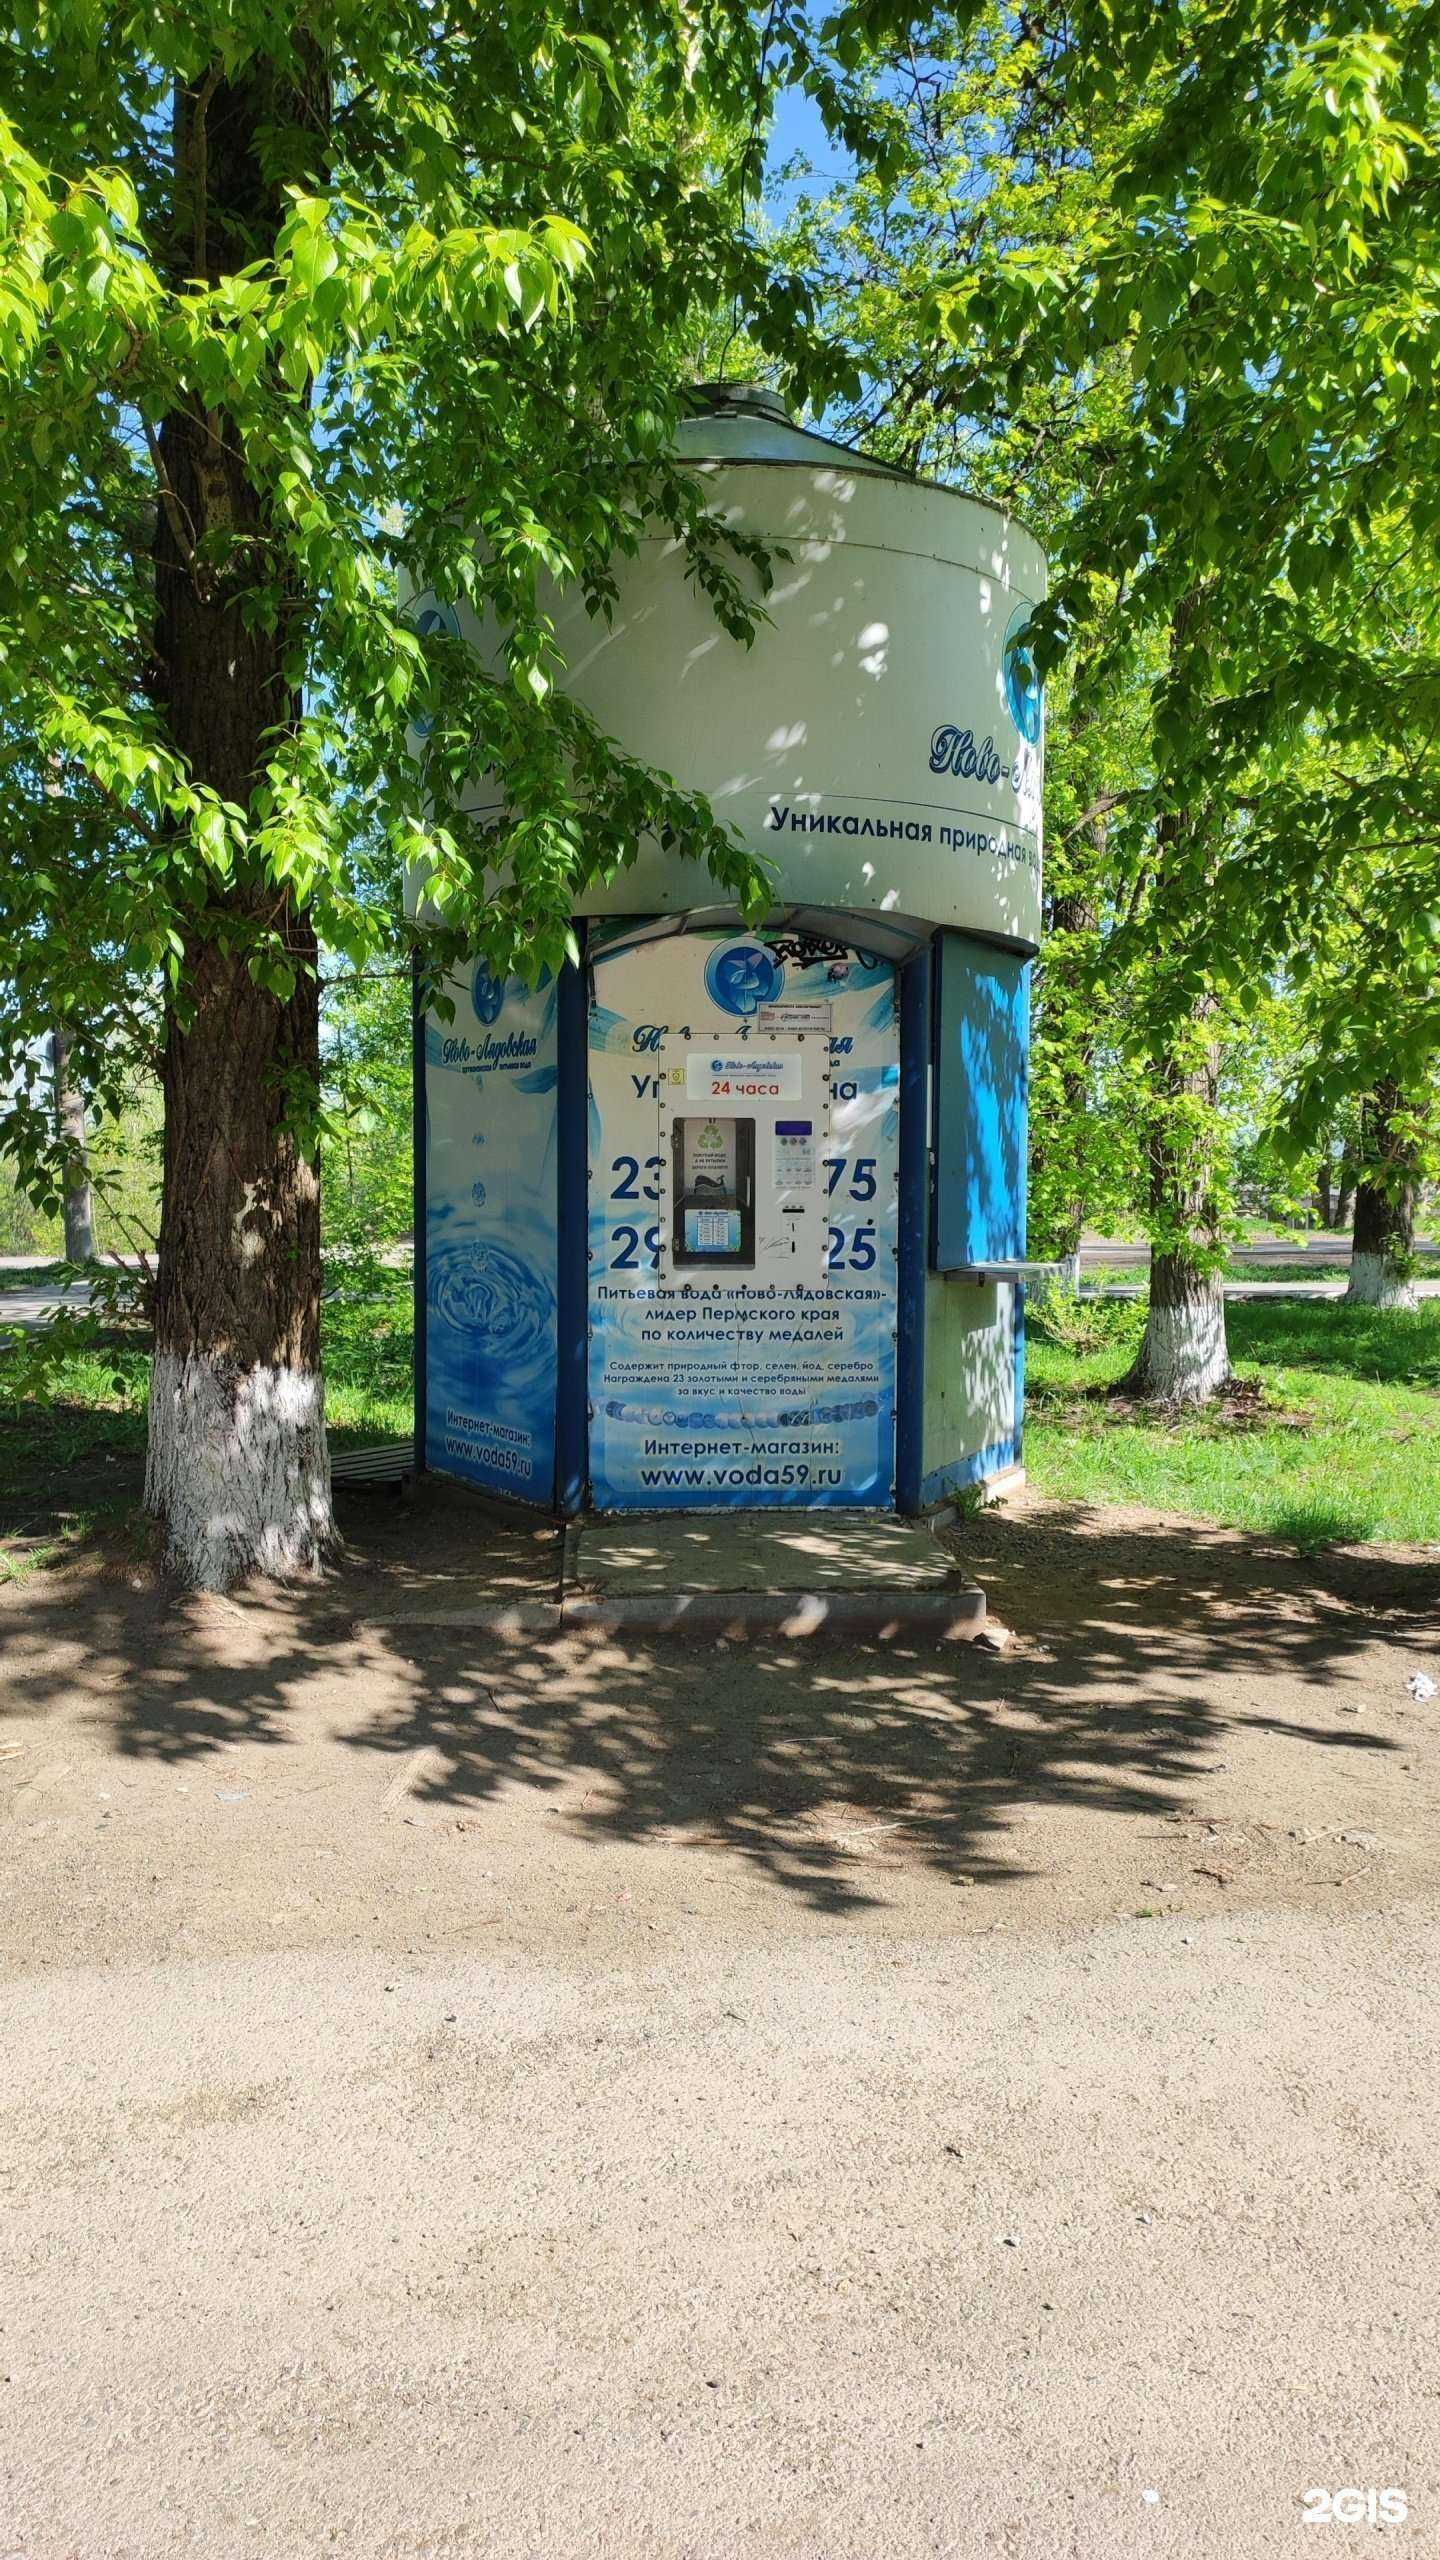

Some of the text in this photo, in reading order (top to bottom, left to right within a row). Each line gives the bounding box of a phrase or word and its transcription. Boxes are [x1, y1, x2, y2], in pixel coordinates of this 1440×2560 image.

[771, 806, 932, 843] Уникальная
[940, 825, 1027, 863] природная
[711, 1081, 780, 1096] 24 часа
[598, 1286, 675, 1299] Питьевая
[681, 1290, 721, 1301] вода
[645, 1307, 840, 1323] лидер Пермского края
[641, 1326, 844, 1343] по количеству медалей
[609, 1361, 664, 1371] Содержит
[668, 1361, 727, 1372] природный
[828, 1361, 874, 1372] серебро
[604, 1375, 670, 1384] Награждена
[673, 1374, 685, 1383] 23
[687, 1375, 738, 1383] золотыми
[751, 1374, 824, 1384] серебряными
[692, 1389, 716, 1397] вкус
[779, 1388, 806, 1396] воды
[446, 1408, 531, 1447] Интернет-магазин:
[446, 1437, 531, 1476] www.voda59.ru
[645, 1439, 840, 1458] Интернет-магазин:
[641, 1464, 841, 1486] www.voda59.ru
